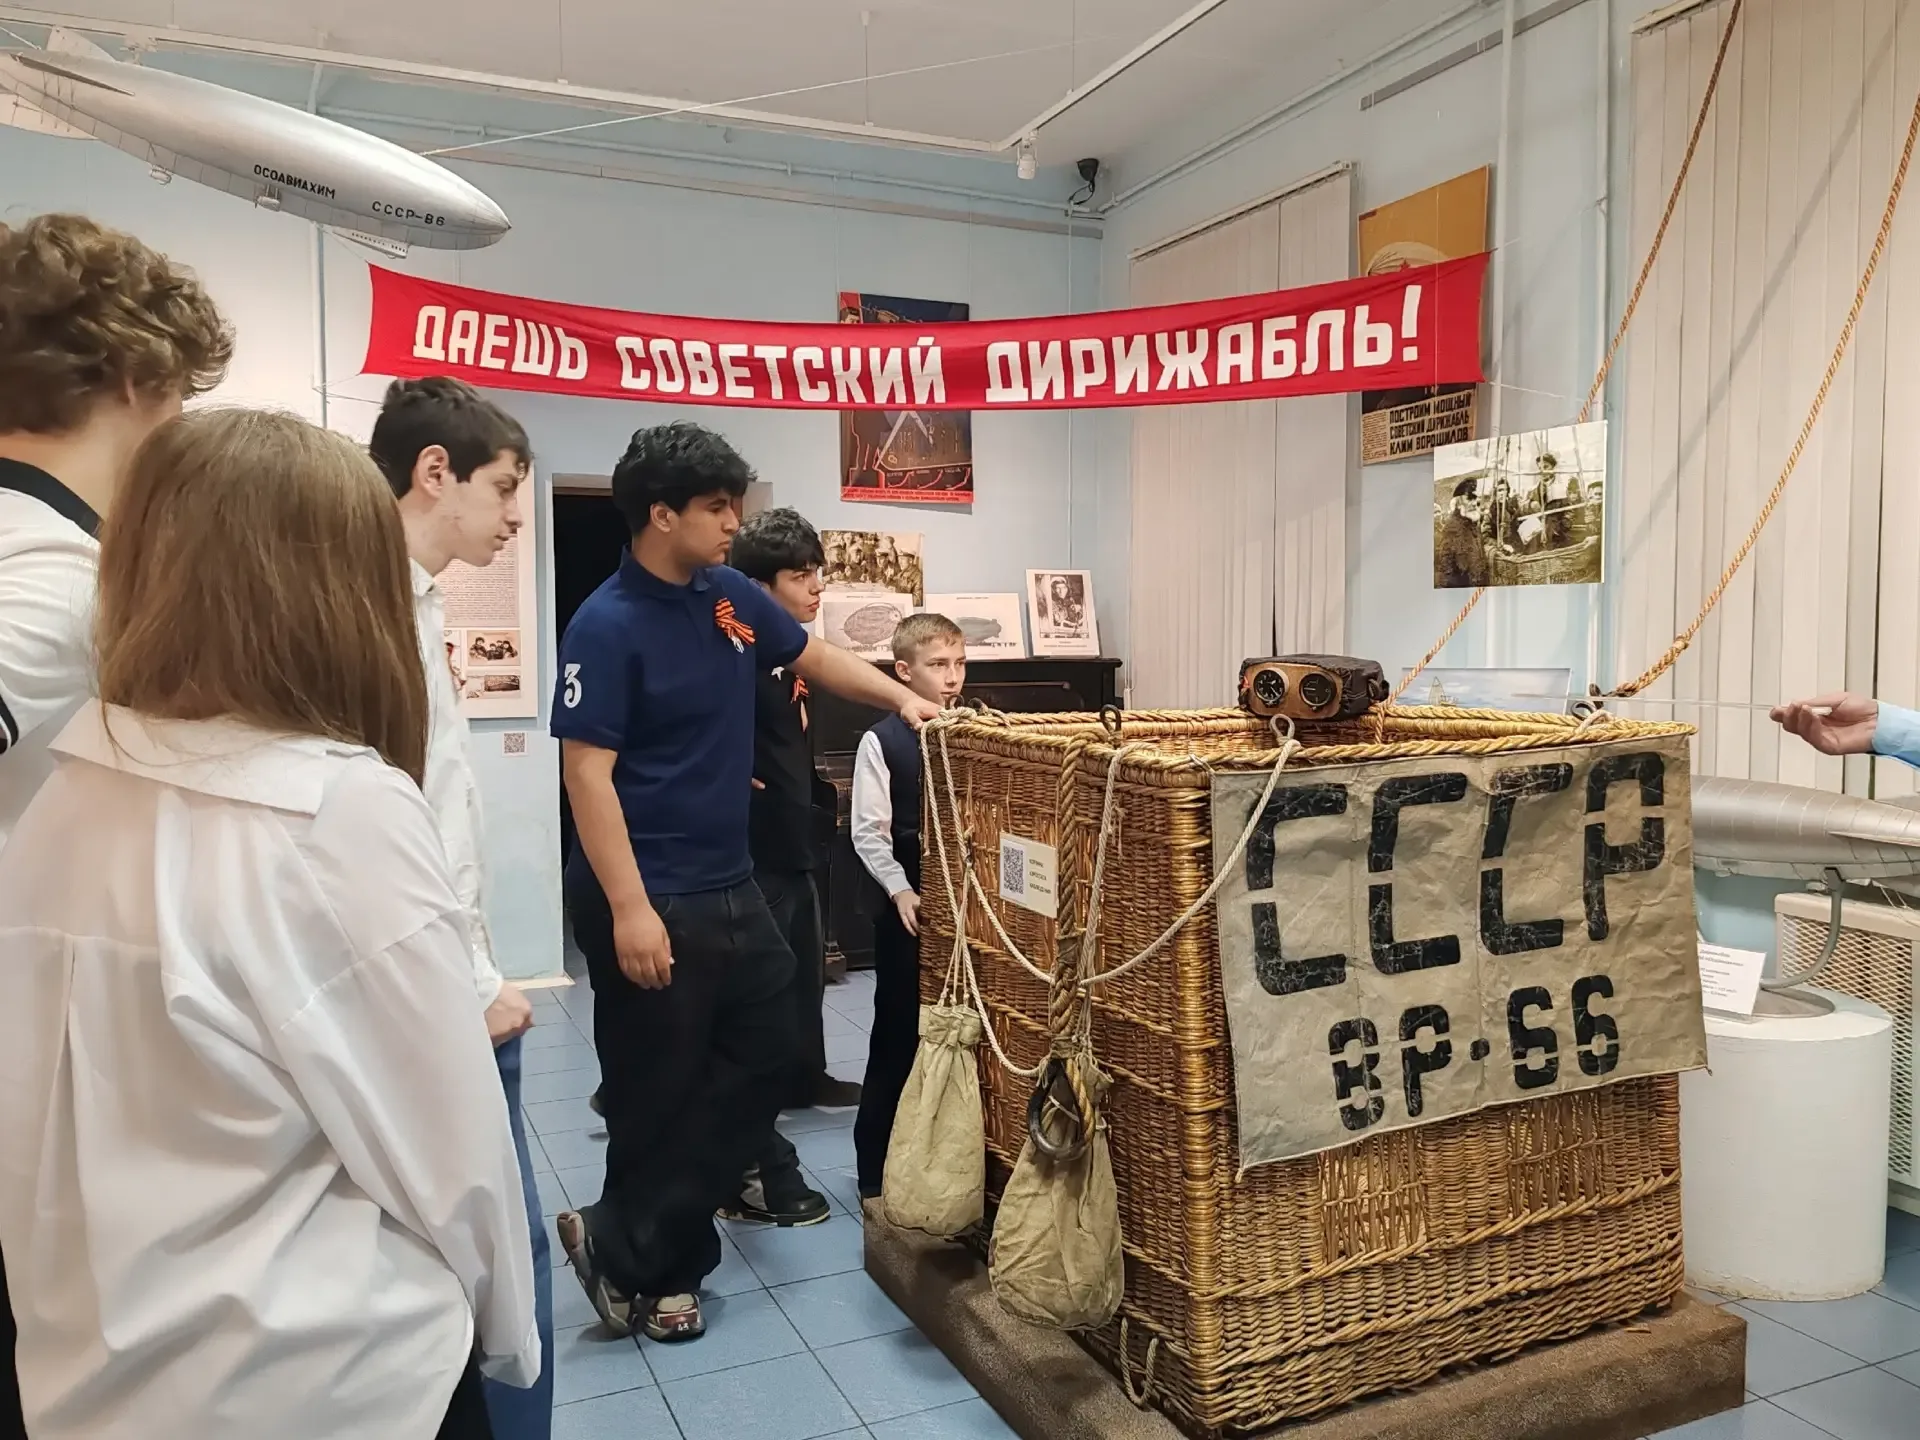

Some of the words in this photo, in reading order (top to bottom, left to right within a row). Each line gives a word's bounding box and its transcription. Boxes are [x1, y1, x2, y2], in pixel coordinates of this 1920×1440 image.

[254, 164, 335, 199] ОСОАВИАХИМ
[372, 200, 445, 227] СССР-В6
[413, 305, 588, 380] ДАЕШЬ
[615, 336, 946, 404] СОВЕТСКИЙ
[985, 284, 1422, 403] ДИРИЖАБЛЬ!
[1390, 402, 1430, 424] ПОСТРОИМ
[1434, 391, 1472, 414] МОЩНЫЙ
[1390, 419, 1425, 439] СОВЕТСКИЙ
[1390, 439, 1413, 456] КЛИМ
[1416, 427, 1469, 450] ВОРОШИЛОВ
[564, 663, 582, 708] 3
[1247, 751, 1664, 996] СССР
